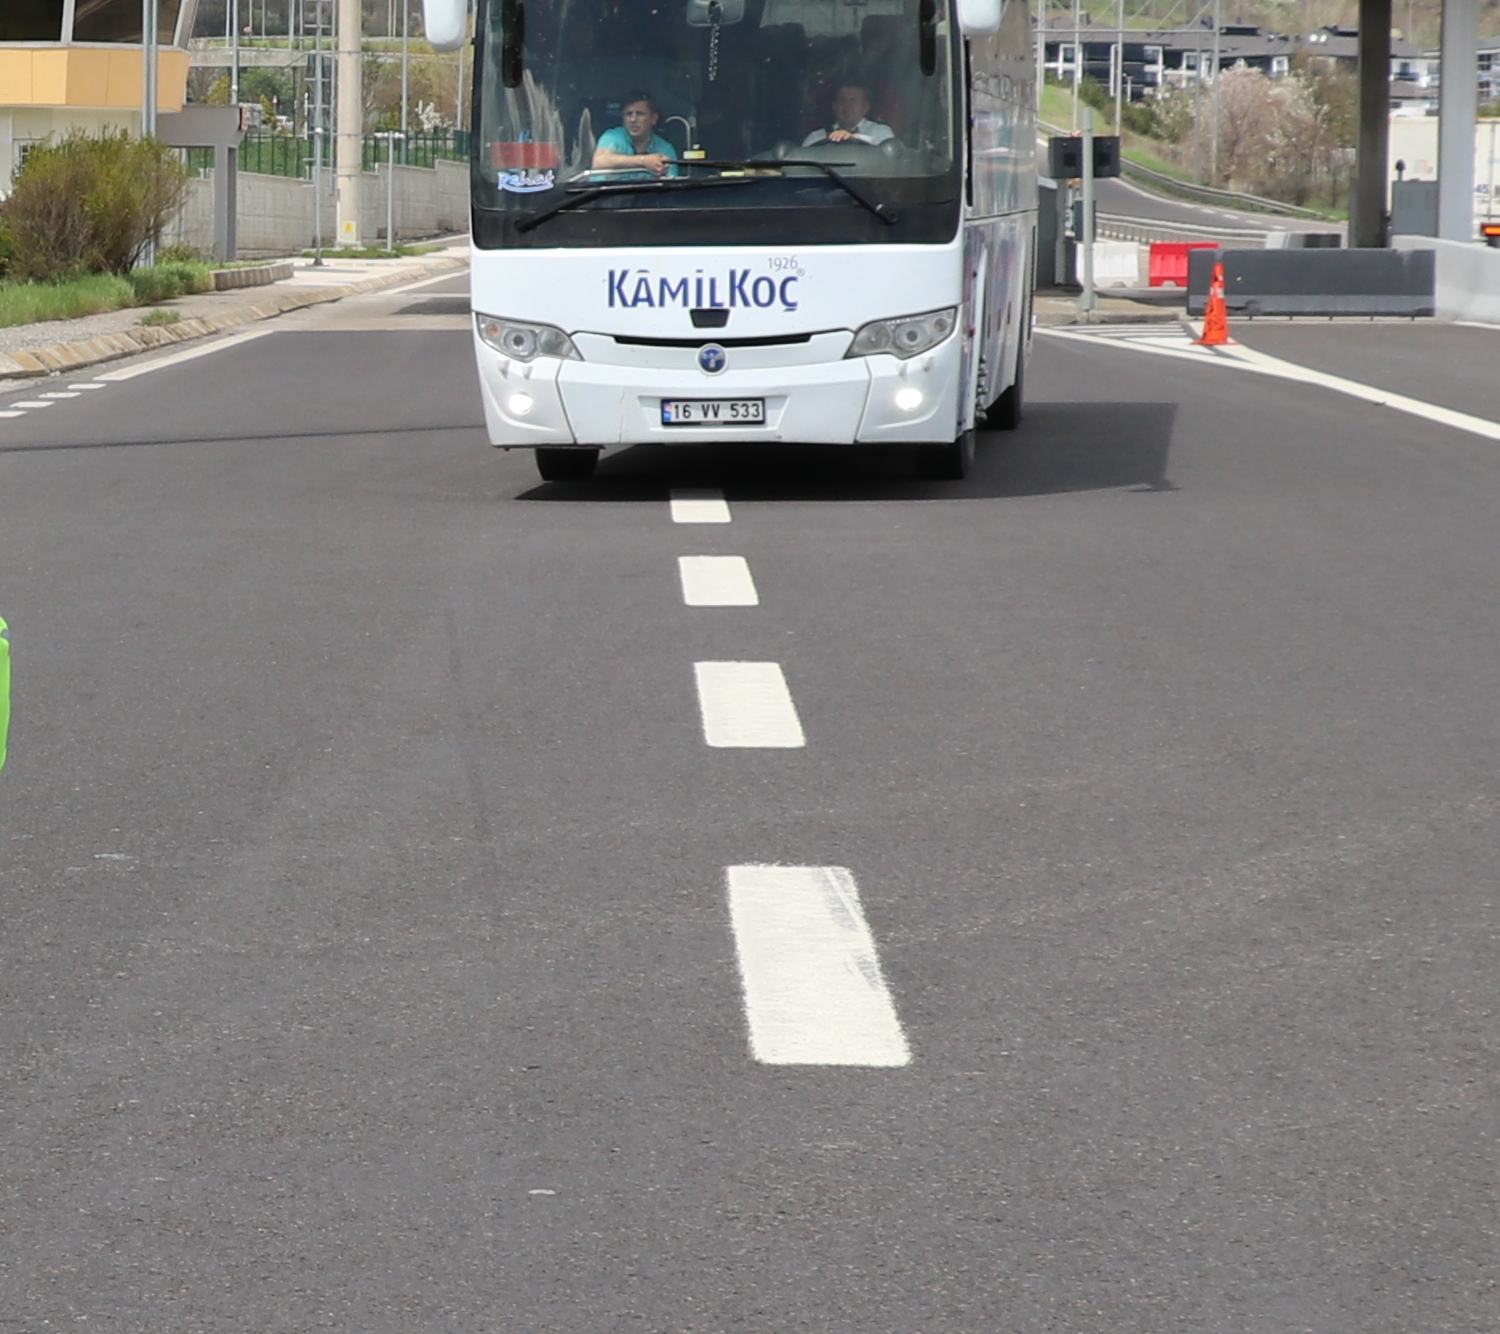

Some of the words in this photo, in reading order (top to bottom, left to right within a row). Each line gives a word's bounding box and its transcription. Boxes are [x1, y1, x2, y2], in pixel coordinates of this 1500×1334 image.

[768, 255, 798, 271] 1926
[674, 404, 692, 419] 16
[701, 403, 720, 418] VV
[730, 403, 760, 418] 533
